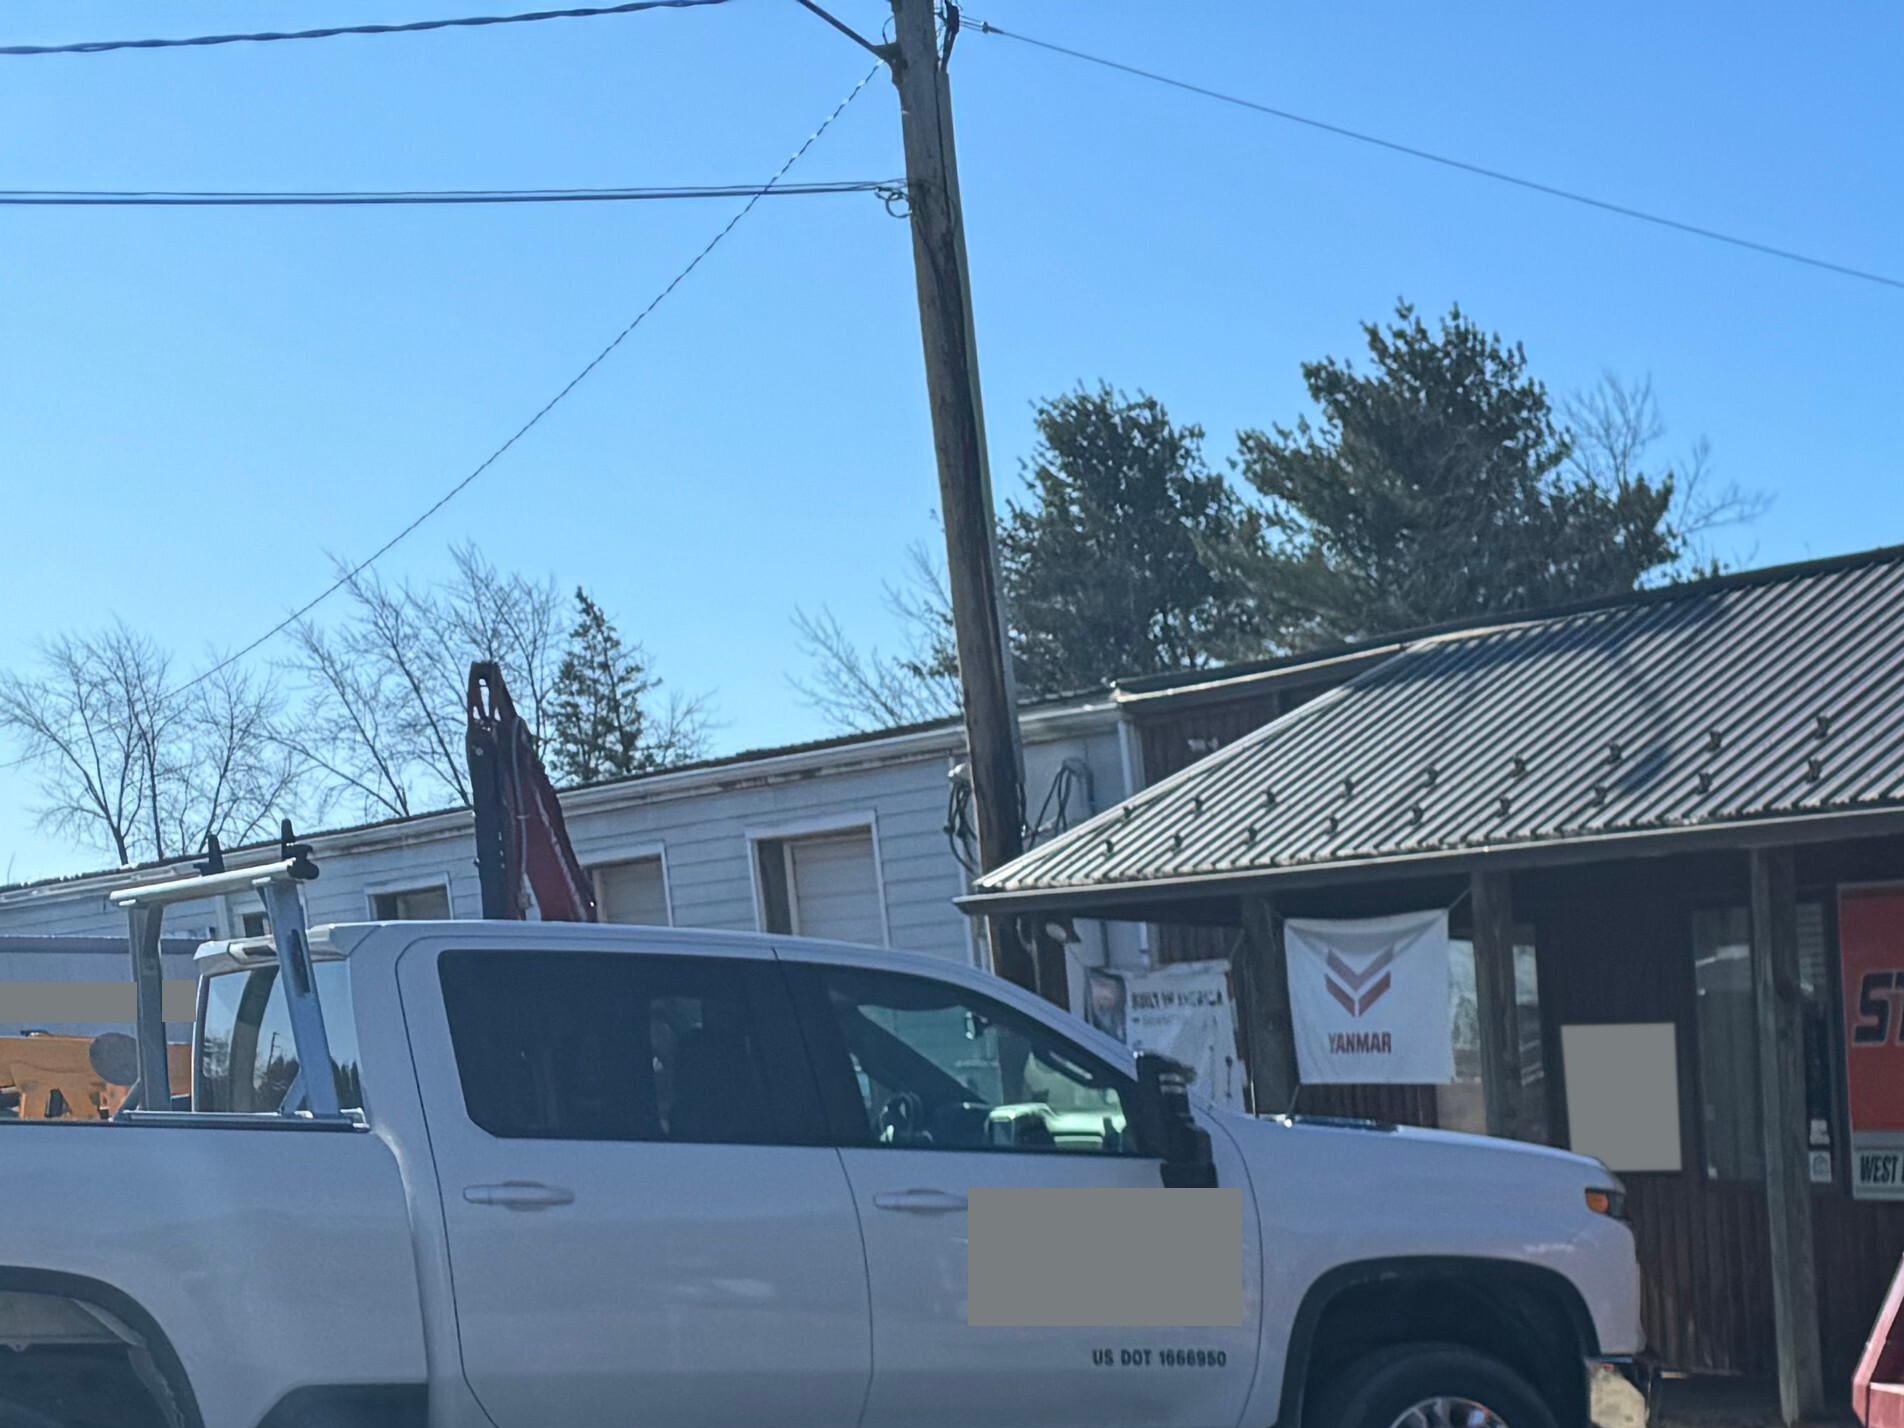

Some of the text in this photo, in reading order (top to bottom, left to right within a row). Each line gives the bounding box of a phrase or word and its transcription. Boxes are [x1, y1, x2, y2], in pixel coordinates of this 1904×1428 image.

[1328, 1032, 1392, 1055] YANMAR
[1859, 1155, 1898, 1184] WEST
[1092, 1349, 1114, 1366] US
[1120, 1349, 1152, 1366] DOT
